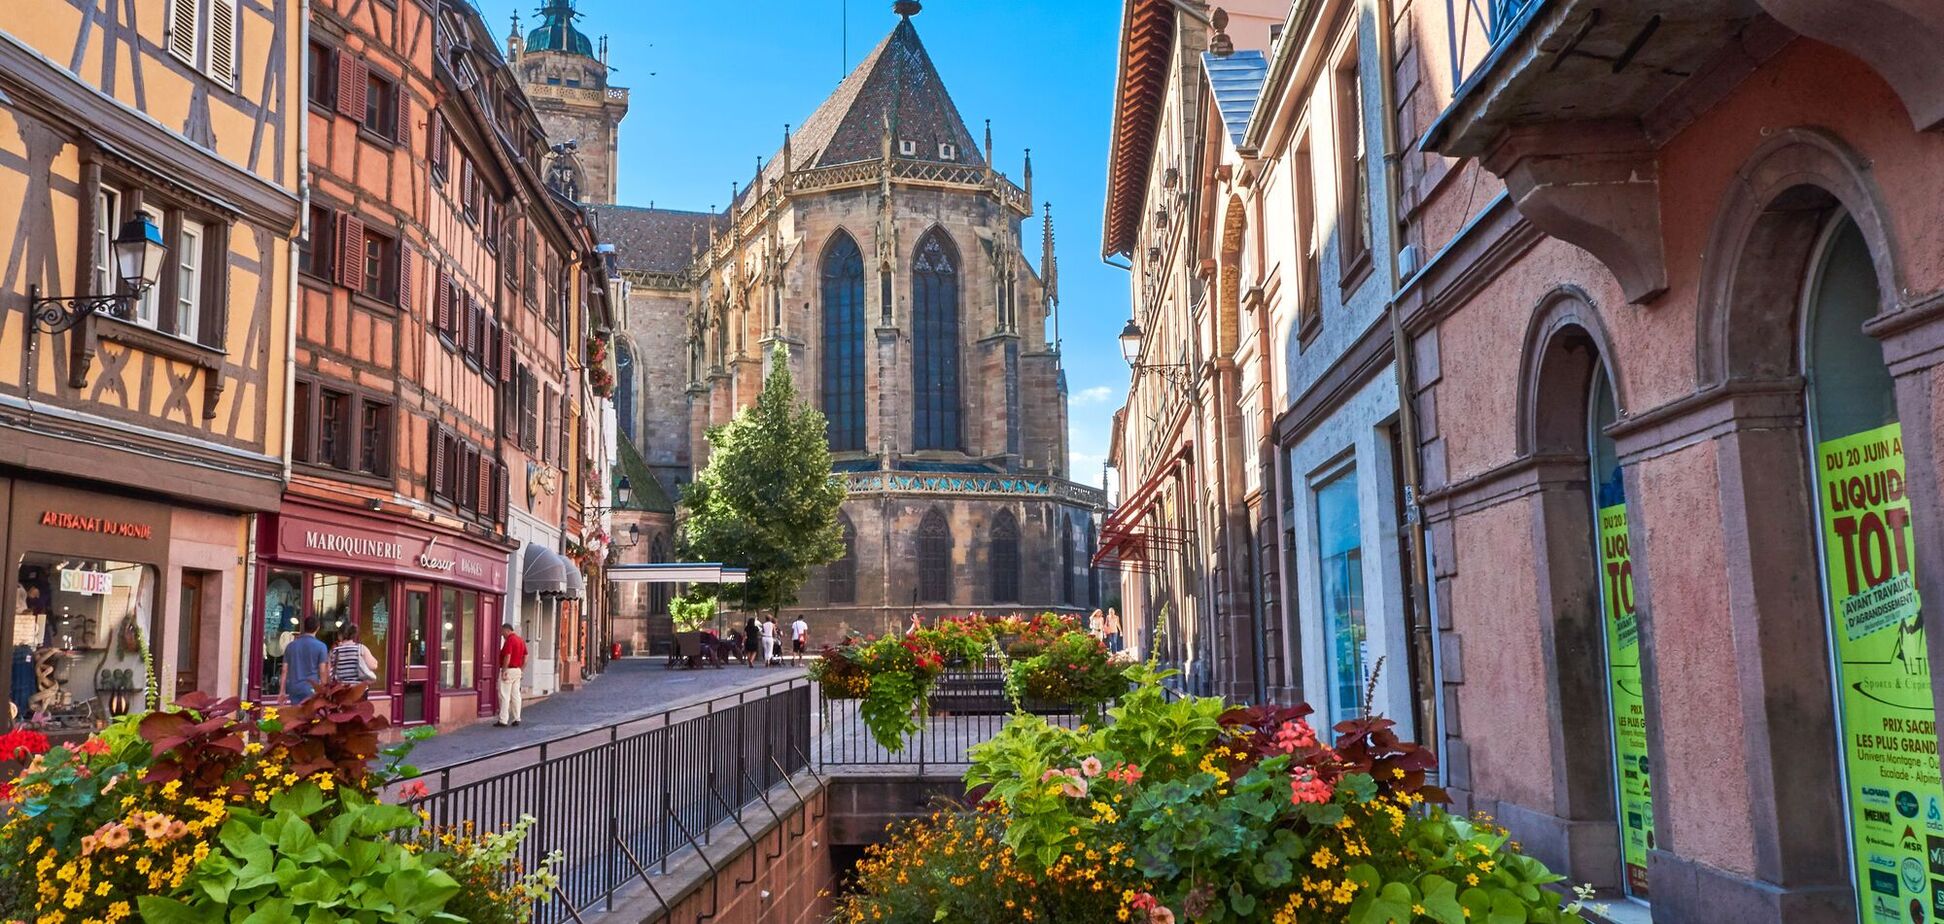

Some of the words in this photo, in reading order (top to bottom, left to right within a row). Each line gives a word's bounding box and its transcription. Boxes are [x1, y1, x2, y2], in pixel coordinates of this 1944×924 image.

[1826, 452, 1843, 471] DU
[1846, 448, 1860, 467] 20
[1863, 440, 1890, 463] JUIN
[1829, 468, 1906, 512] LIQUID
[42, 511, 101, 532] ARTISANAT
[103, 520, 118, 535] DU
[119, 522, 152, 540] MONDE
[306, 530, 403, 560] MAROQUINERIE
[1832, 507, 1919, 596] TOT
[62, 571, 112, 594] SOLDES
[1846, 593, 1873, 616] AVANT
[1873, 576, 1911, 603] TRAVAUX
[1848, 592, 1914, 628] D'AGRANDISSEMENT
[1882, 717, 1904, 733] PRIX
[1856, 733, 1873, 748] LES
[1875, 735, 1898, 752] PLUS
[1857, 749, 1887, 763] Univers
[1887, 753, 1921, 769] Montagne
[1904, 841, 1923, 853] MSR
